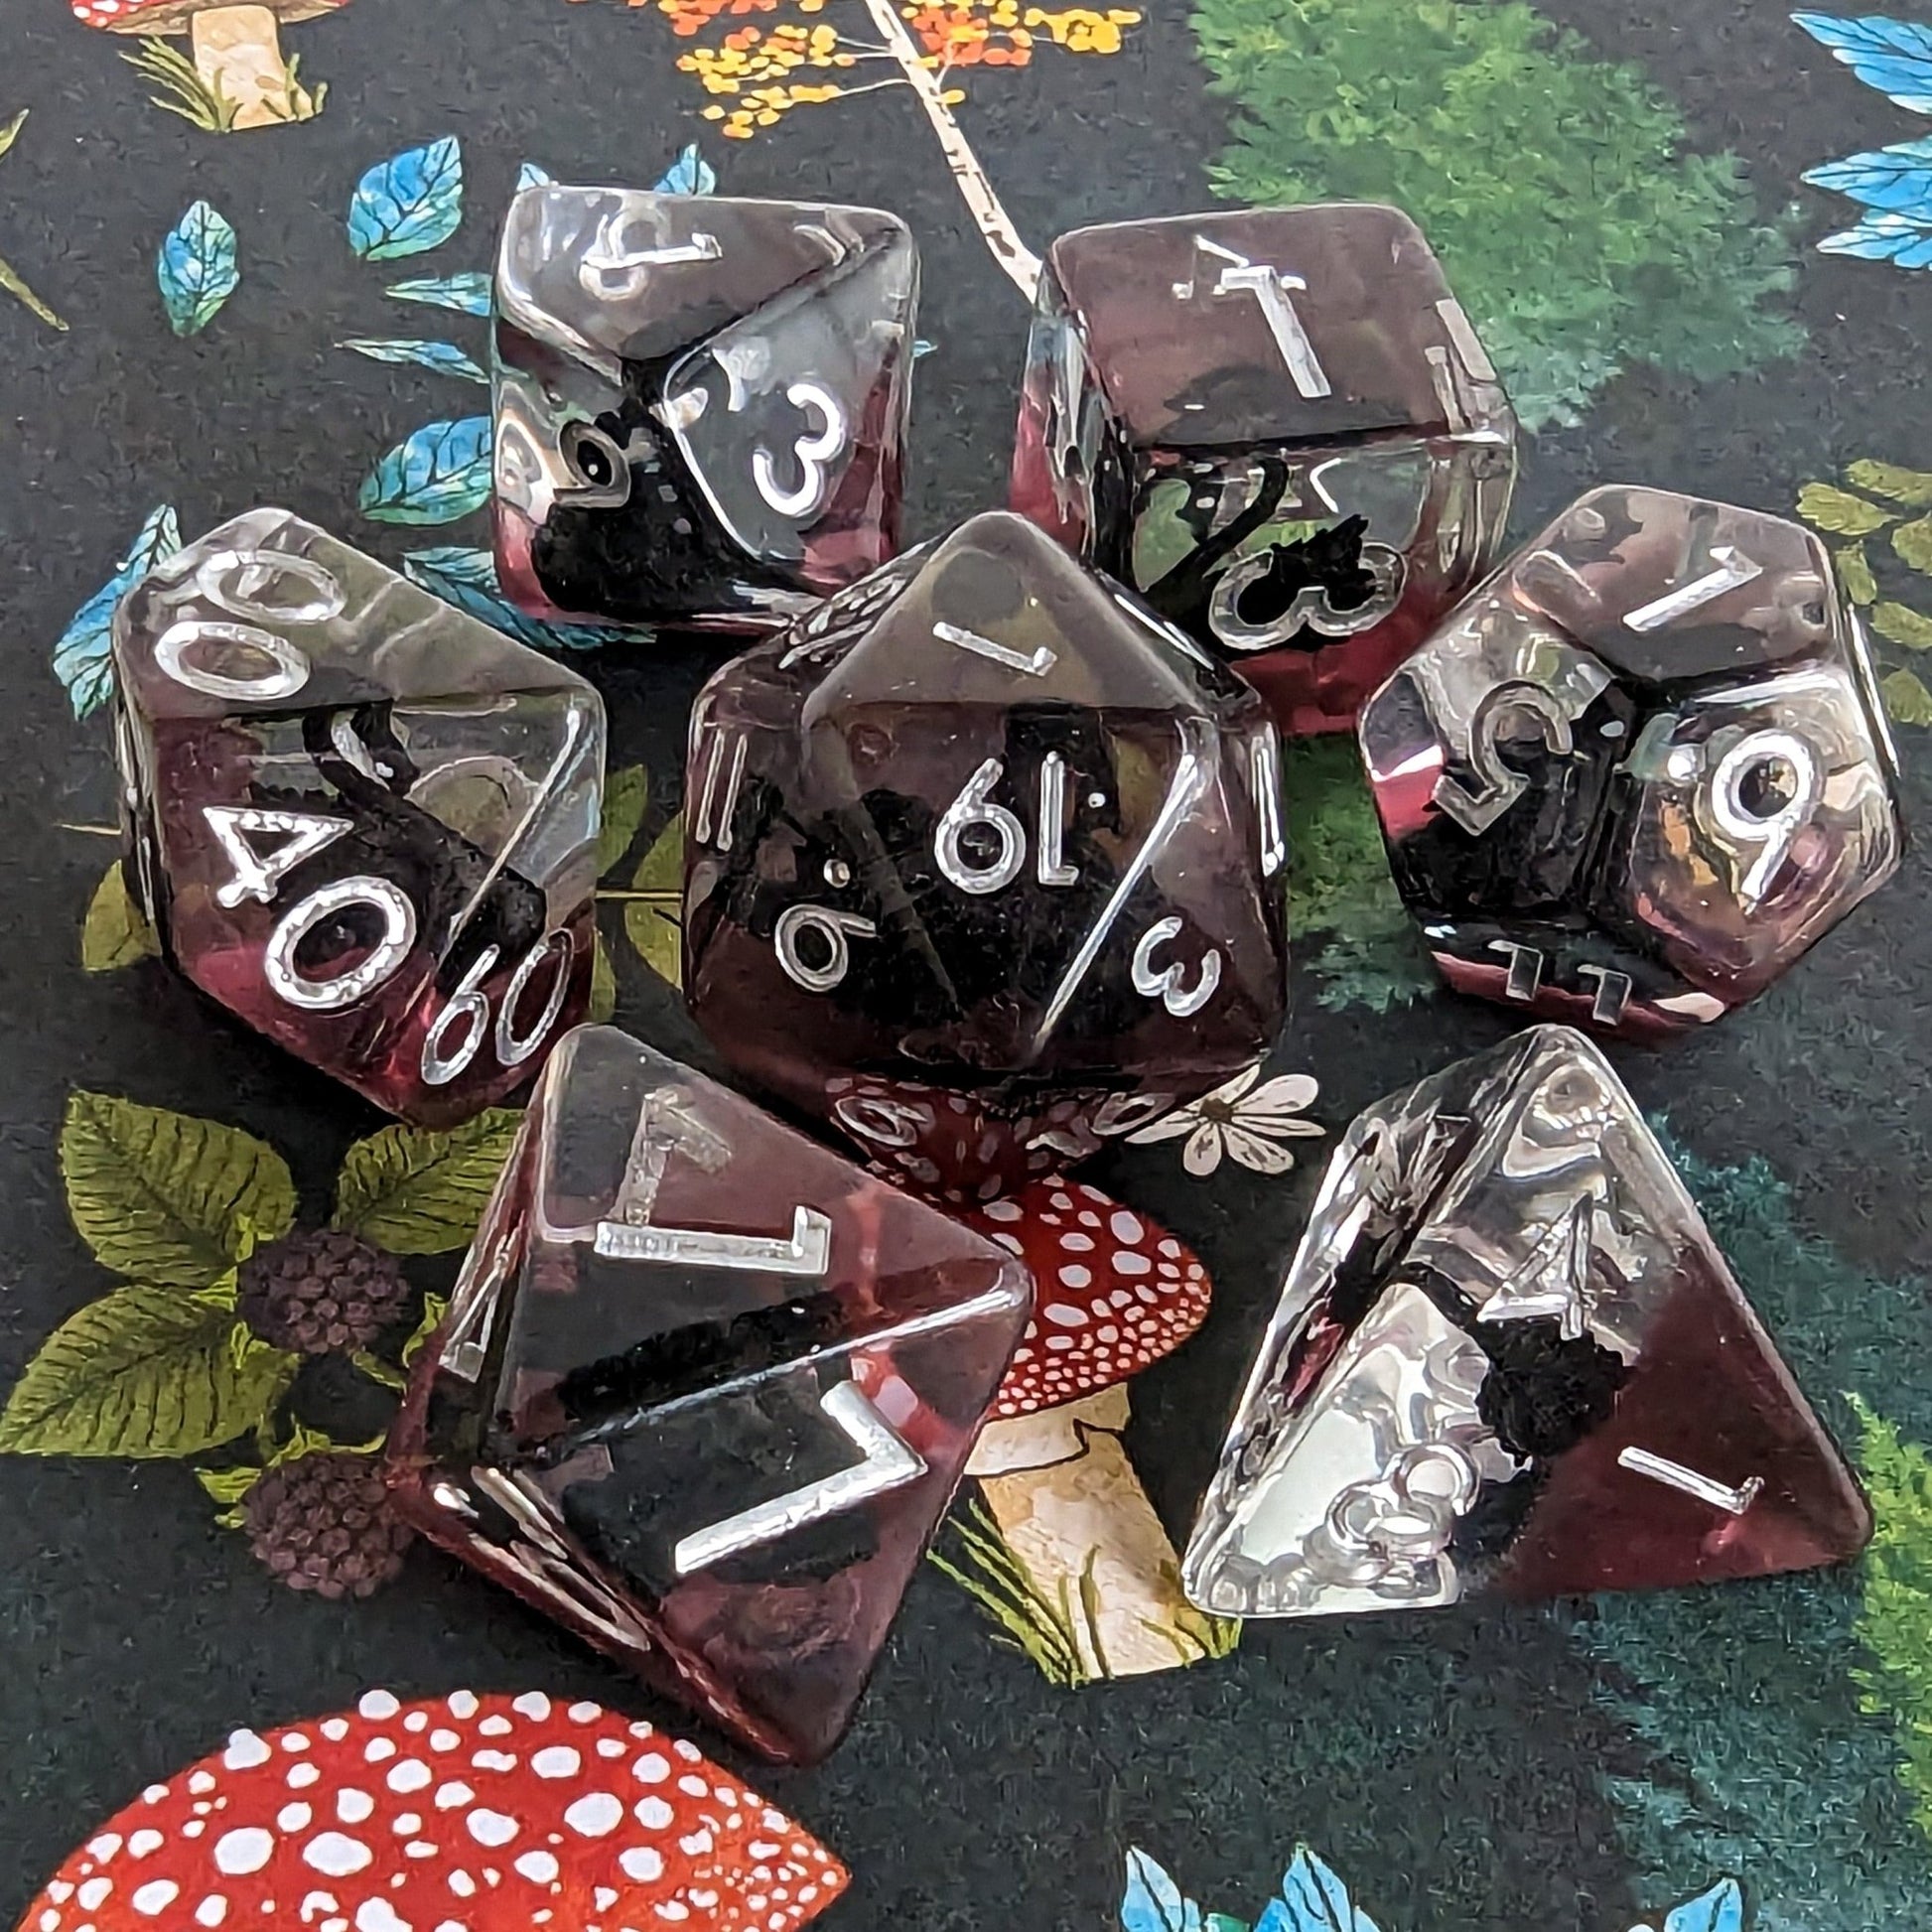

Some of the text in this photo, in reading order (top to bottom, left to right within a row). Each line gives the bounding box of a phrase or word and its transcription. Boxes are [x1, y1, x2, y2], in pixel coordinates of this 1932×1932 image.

[1220, 265, 1332, 398] 1
[752, 382, 846, 516] 3
[155, 548, 347, 700] 00
[931, 621, 1058, 677] 1
[1622, 546, 1763, 632] 1
[204, 805, 418, 1011] 40
[1131, 915, 1222, 1017] 3
[421, 927, 574, 1086] 60
[1617, 1446, 1764, 1515] 1
